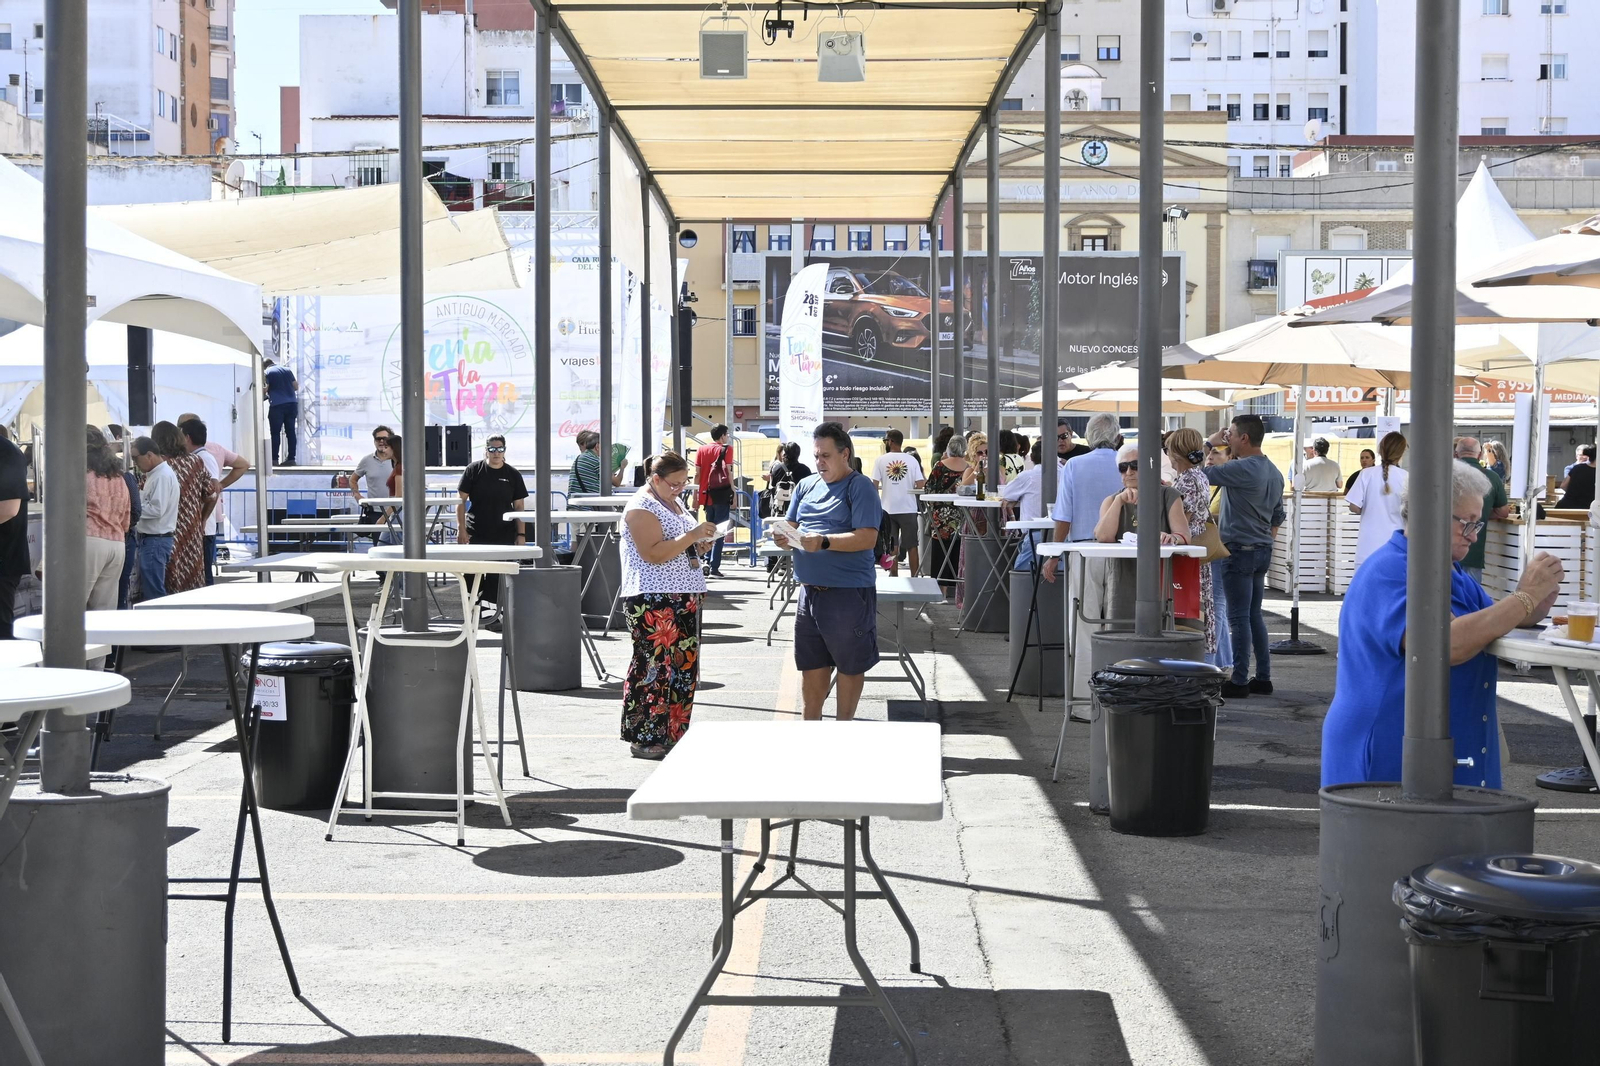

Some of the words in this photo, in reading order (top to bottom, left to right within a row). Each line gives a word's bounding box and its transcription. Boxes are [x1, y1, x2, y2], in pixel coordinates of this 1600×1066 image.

[1082, 185, 1117, 195] ANNO
[1100, 272, 1138, 288] Inglés
[803, 294, 814, 304] 28
[436, 302, 487, 319] ANTIGUO
[487, 312, 527, 359] MERCADO
[424, 327, 496, 371] eria
[1069, 345, 1100, 353] NUEVO
[328, 355, 351, 365] FOE
[560, 357, 595, 367] viajes
[458, 359, 481, 387] la
[432, 368, 521, 417] Tapa
